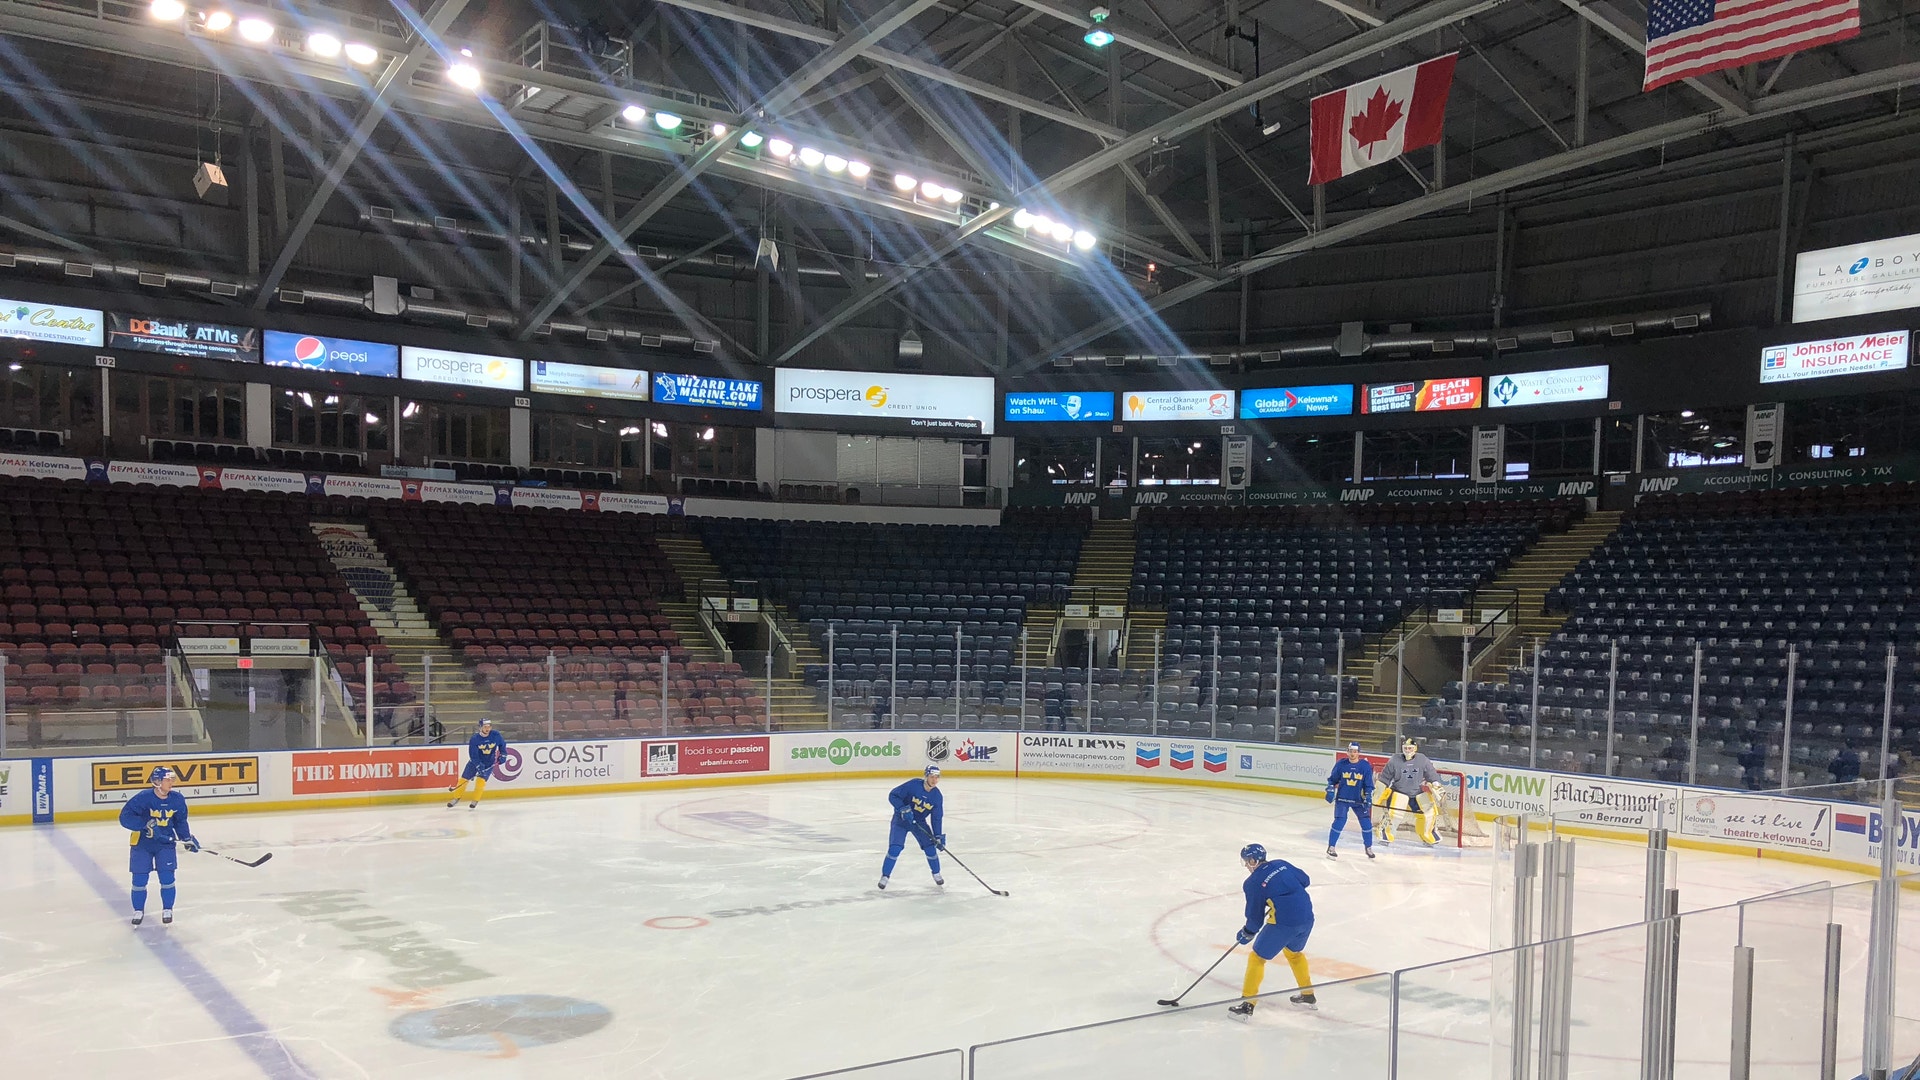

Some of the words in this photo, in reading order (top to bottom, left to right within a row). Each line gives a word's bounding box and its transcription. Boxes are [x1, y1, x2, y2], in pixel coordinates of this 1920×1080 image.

[1806, 276, 1865, 288] FURNITURE
[30, 308, 95, 331] Centre
[10, 329, 42, 337] LIFESTYLE
[130, 318, 188, 338] DCBank
[195, 327, 238, 344] ATMs
[138, 337, 164, 345] locations
[164, 340, 198, 349] throughout
[208, 345, 237, 353] concourse
[1793, 340, 1854, 357] Johnston
[1860, 334, 1905, 349] Meier
[98, 357, 115, 367] 102
[330, 349, 369, 364] pepsi
[1801, 348, 1893, 369] INSURANCE
[417, 356, 484, 374] prospera
[1810, 366, 1847, 376] Insurance
[1850, 363, 1876, 372] Needs!
[676, 376, 726, 390] WIZARD
[729, 381, 760, 393] LAKE
[1432, 378, 1470, 392] BEACH
[680, 387, 757, 402] MARINE.COM
[790, 385, 861, 403] prospera
[1543, 387, 1575, 396] CANADA
[516, 398, 529, 406] 103
[1173, 396, 1207, 405] Okanagan
[1255, 398, 1287, 409] Global
[1297, 395, 1338, 404] Kelowna's
[1371, 393, 1411, 405] Kelowna's
[1022, 406, 1046, 414] Shaw.
[1306, 404, 1328, 412] News
[1372, 403, 1389, 412] Best
[1390, 400, 1410, 410] Rock
[954, 421, 978, 429] Prosper.
[110, 465, 146, 474] RE/MAX
[224, 473, 256, 482] RE/MAX
[327, 479, 357, 487] RE/MAX
[1640, 477, 1678, 492] MNP
[1704, 474, 1768, 485] ACCOUNTING
[1788, 468, 1853, 480] CONSULTING
[1872, 466, 1892, 476] TAX
[423, 486, 451, 494] RE/MAX
[513, 490, 540, 498] RE/MAX
[1340, 489, 1375, 501] MNP
[1387, 488, 1443, 498] ACCOUNTING
[1459, 486, 1514, 496] CONSULTING
[1528, 485, 1544, 494] TAX
[1558, 481, 1594, 496] MNP
[601, 496, 628, 504] RE/MAX
[1064, 492, 1096, 504] MNP
[1135, 492, 1168, 504] MNP
[1180, 493, 1233, 501] ACCOUNTING
[1249, 491, 1297, 500] CONSULTING
[1312, 491, 1327, 499] TAX
[1023, 736, 1073, 748] CAPITAL
[1136, 740, 1160, 748] Chevron
[1170, 742, 1194, 750] Chevron
[1203, 744, 1228, 752] Chevron
[534, 744, 608, 764] COAST
[684, 746, 704, 755] food
[706, 746, 713, 754] is
[730, 744, 764, 755] passion
[931, 741, 946, 757] NHL
[968, 746, 990, 759] CHL
[1023, 751, 1125, 761] www.kelownacapnews.com
[700, 759, 749, 767] urbanfare.com
[99, 762, 252, 786] LEVITT
[293, 765, 334, 782] THE
[338, 761, 393, 780] HOME
[535, 766, 570, 782] capri
[574, 764, 610, 779] hotel
[1490, 798, 1545, 812] SOLUTIONS
[1596, 812, 1643, 824] Bernard
[1684, 815, 1715, 824] Kelowna
[1724, 815, 1745, 823] see
[1751, 814, 1767, 826] it
[1772, 813, 1802, 829] live
[1723, 827, 1823, 847] theatre.kelowna.ca
